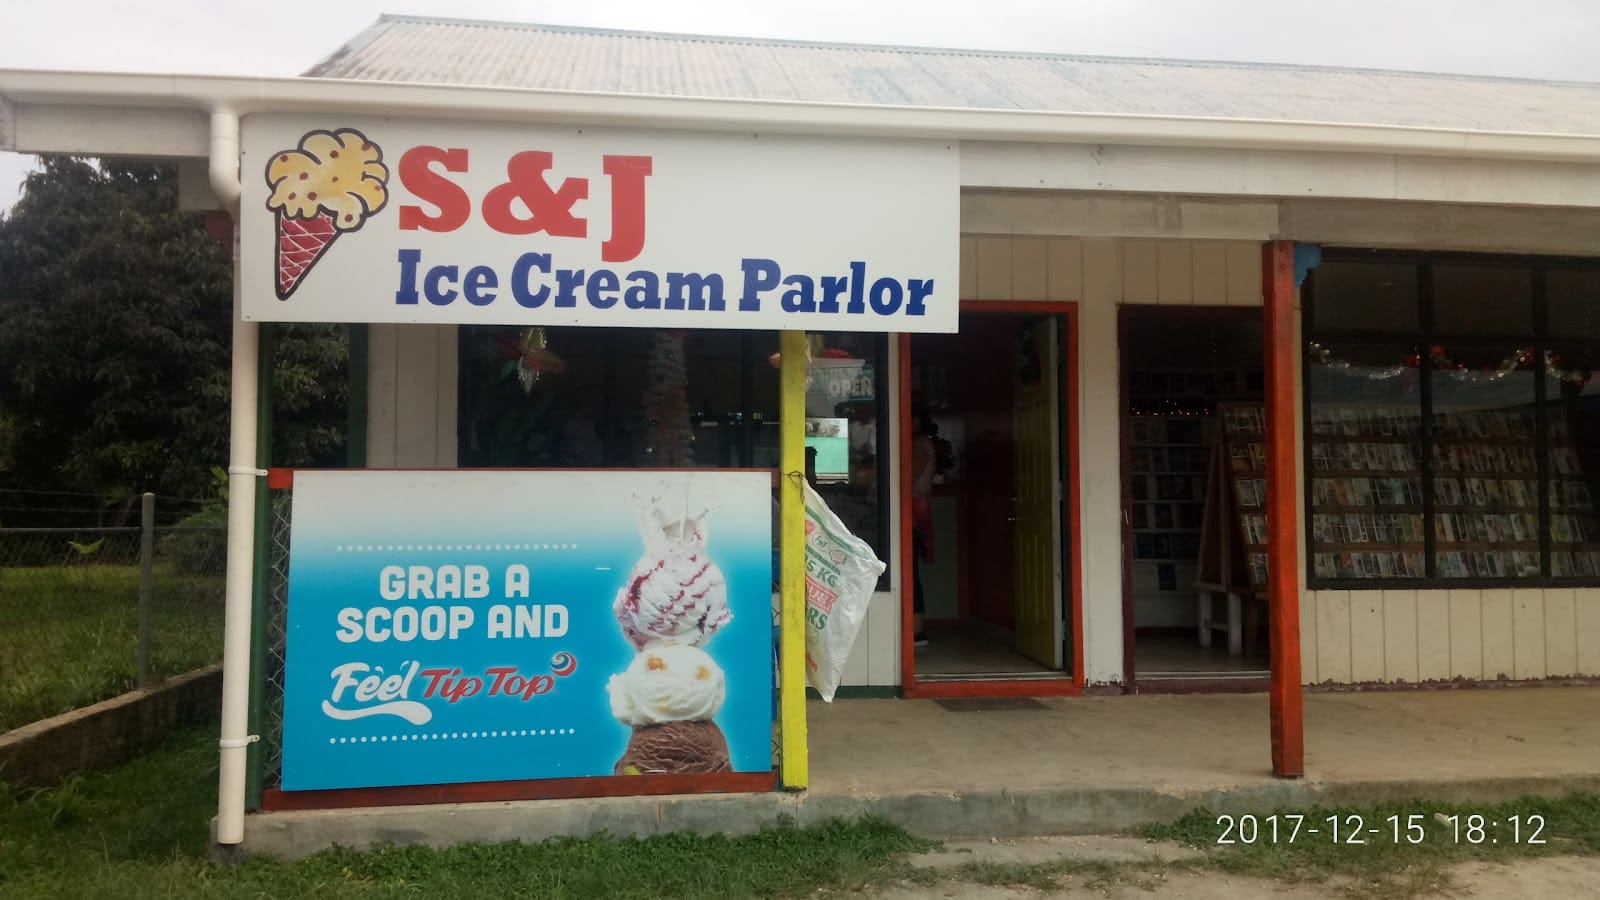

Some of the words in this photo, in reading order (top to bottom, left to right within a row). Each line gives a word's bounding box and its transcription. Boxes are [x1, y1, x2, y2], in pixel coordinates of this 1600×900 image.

[396, 249, 498, 306] Ice
[511, 252, 726, 312] Cream
[740, 258, 935, 316] Parlor
[828, 376, 873, 398] OPEN
[379, 565, 490, 601] GRAB
[505, 563, 530, 599] A
[336, 605, 475, 643] SCOOP
[487, 604, 569, 639] AND
[807, 606, 828, 630] RS
[420, 668, 484, 705] Tip
[485, 667, 555, 701] Top
